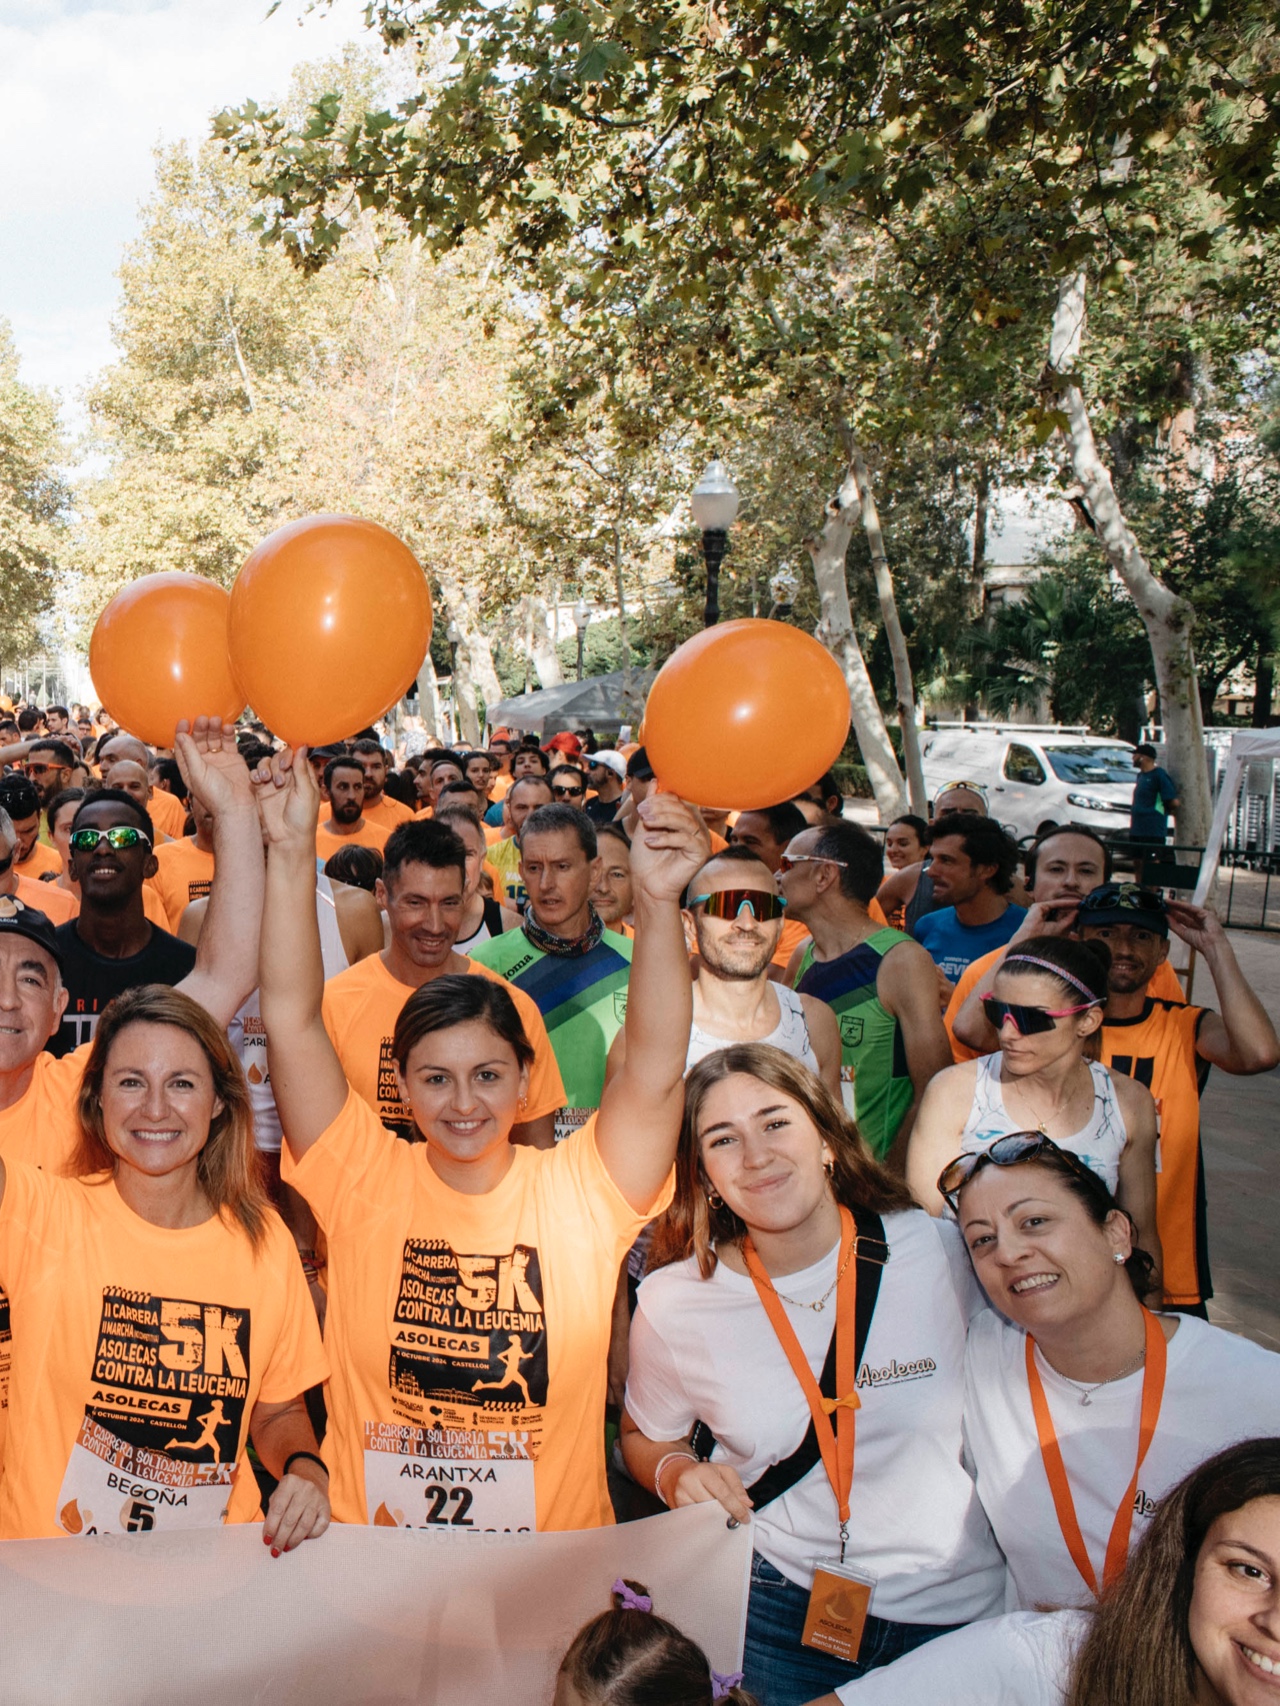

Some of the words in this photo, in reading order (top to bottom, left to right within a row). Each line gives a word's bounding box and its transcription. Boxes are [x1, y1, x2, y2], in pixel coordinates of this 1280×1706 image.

[406, 1262, 430, 1281] MARCHA
[411, 1252, 457, 1270] CARRERA
[400, 1279, 454, 1306] ASOLECAS
[456, 1248, 542, 1313] 5K
[105, 1302, 111, 1317] II
[113, 1304, 158, 1326] CARRERA
[397, 1301, 450, 1327] CONTRA
[455, 1309, 471, 1328] LA
[475, 1311, 544, 1332] LEUCEMIA
[107, 1321, 134, 1337] MARCHA
[159, 1300, 248, 1379] 5K
[395, 1331, 480, 1353] ASOLECAS
[98, 1338, 157, 1366] ASOLECAS
[401, 1351, 430, 1362] OCTUBRE
[432, 1357, 447, 1365] 2024
[95, 1359, 154, 1388] CONTRA
[158, 1370, 176, 1390] LA
[179, 1372, 246, 1399] LEUCEMIA
[856, 1357, 937, 1388] Asolecas
[92, 1391, 181, 1414] ASOLECAS
[97, 1411, 128, 1421] OCTUBRE
[129, 1415, 145, 1424] 2024
[93, 1424, 133, 1459] CARRERA
[136, 1449, 194, 1475] SOLIDARIA
[195, 1463, 238, 1485] 5K
[370, 1436, 410, 1454] CONTRA
[414, 1442, 428, 1456] LA
[431, 1444, 487, 1459] LEUCEMIA
[379, 1423, 424, 1442] CARRERA
[426, 1428, 485, 1446] SOLIDARIA
[488, 1431, 529, 1459] 5K
[82, 1433, 117, 1465] CONTRA
[120, 1458, 133, 1475] LA
[136, 1464, 194, 1488] LEUCEMIA
[400, 1463, 497, 1483] ARANTXA
[106, 1472, 188, 1507] BEGOÑA
[127, 1501, 155, 1533] 5
[424, 1485, 474, 1526] 22
